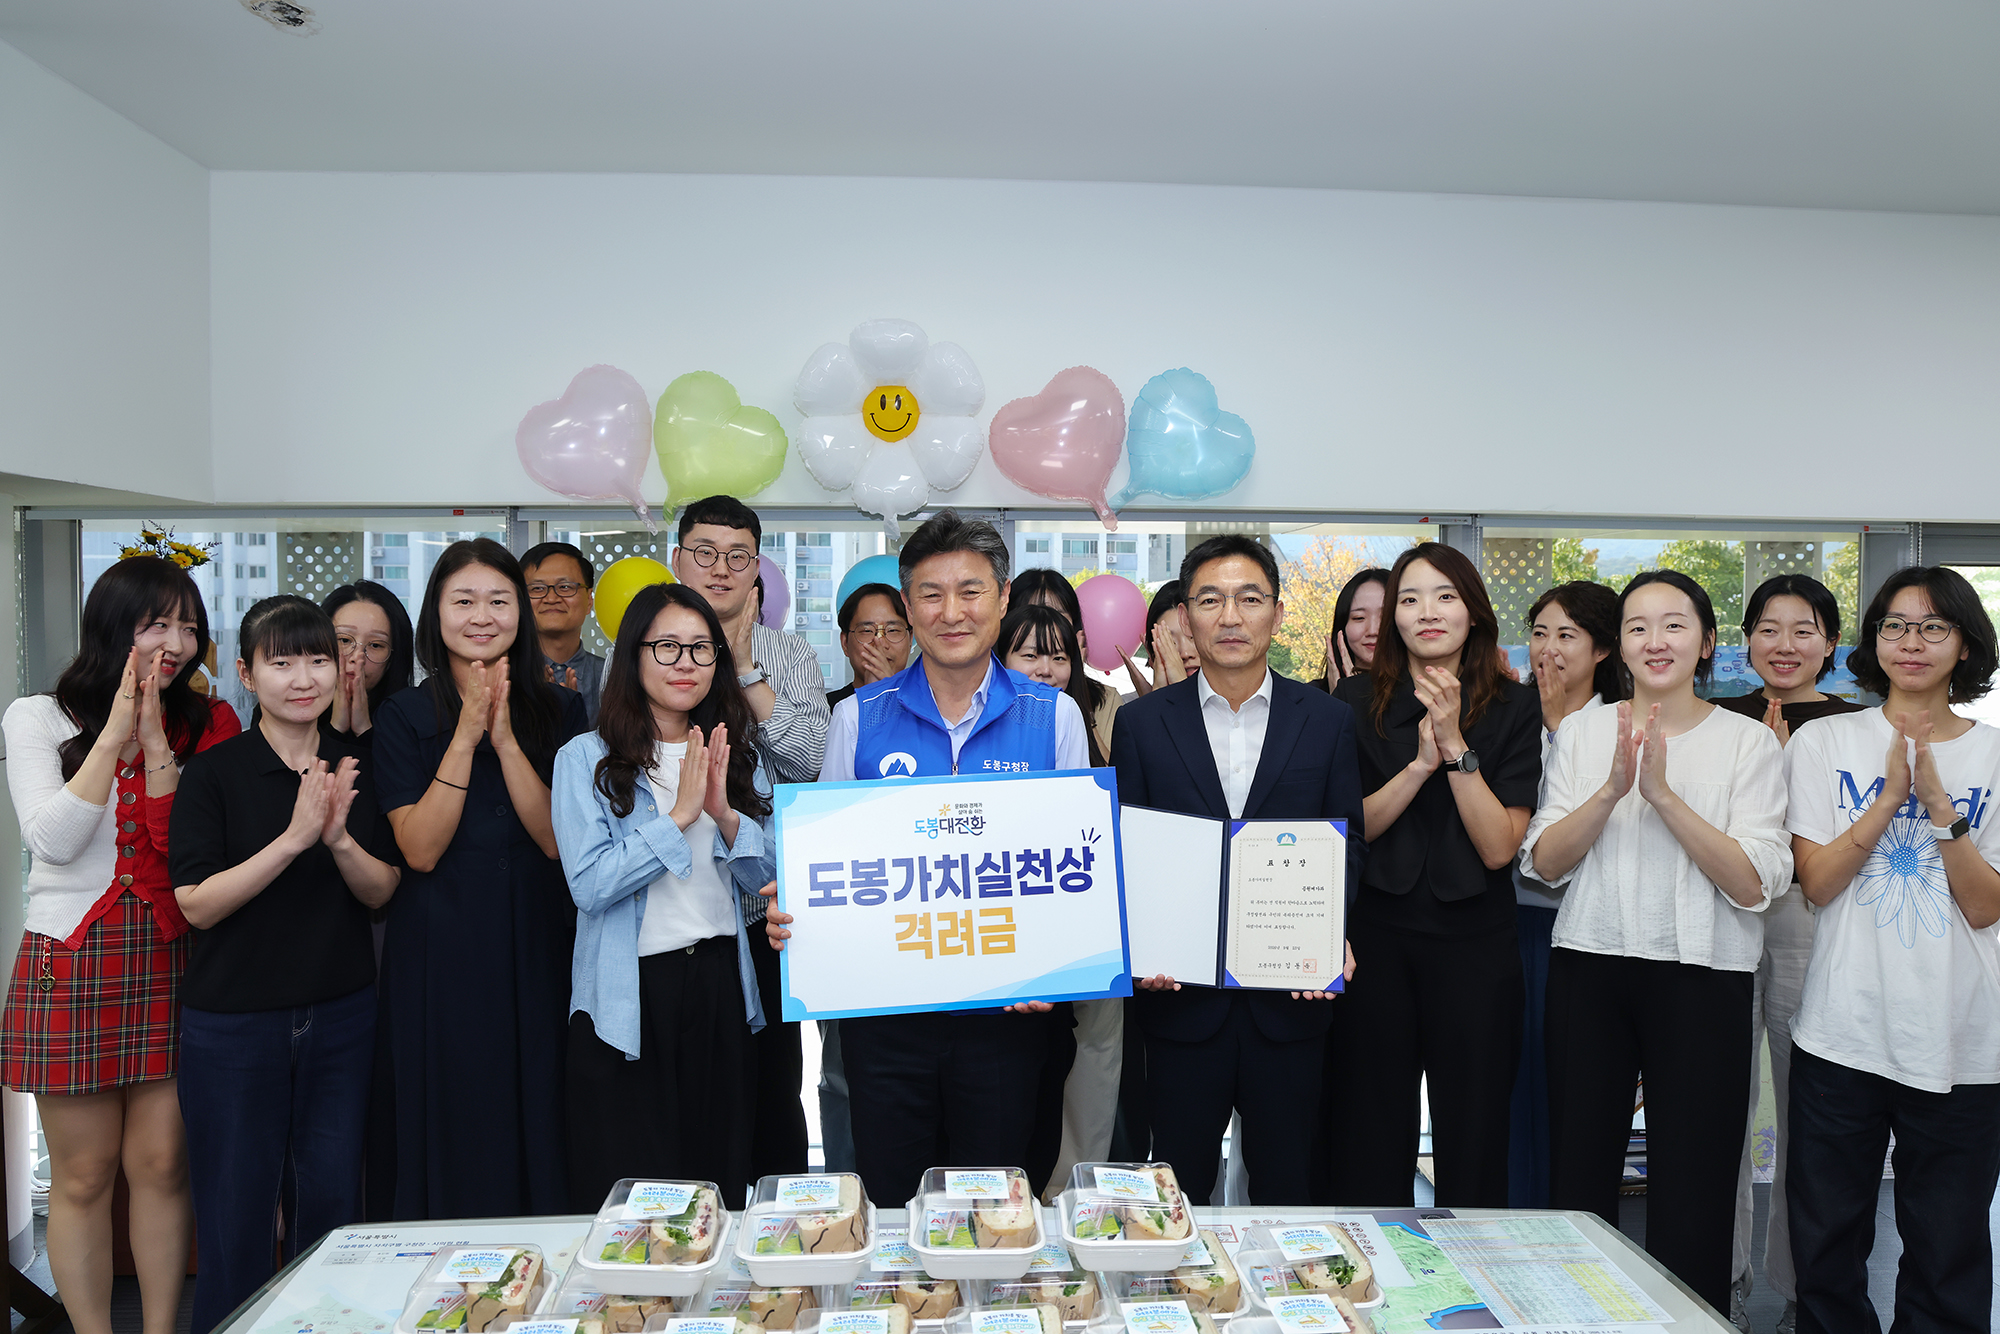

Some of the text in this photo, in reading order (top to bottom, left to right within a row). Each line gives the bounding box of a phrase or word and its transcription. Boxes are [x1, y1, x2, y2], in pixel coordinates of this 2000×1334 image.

[982, 759, 1029, 772] 도봉구청장
[1836, 769, 1991, 829] Madi
[914, 815, 986, 839] 도봉대전환
[808, 845, 1095, 907] 도봉가치실천상
[894, 906, 1017, 960] 격려금
